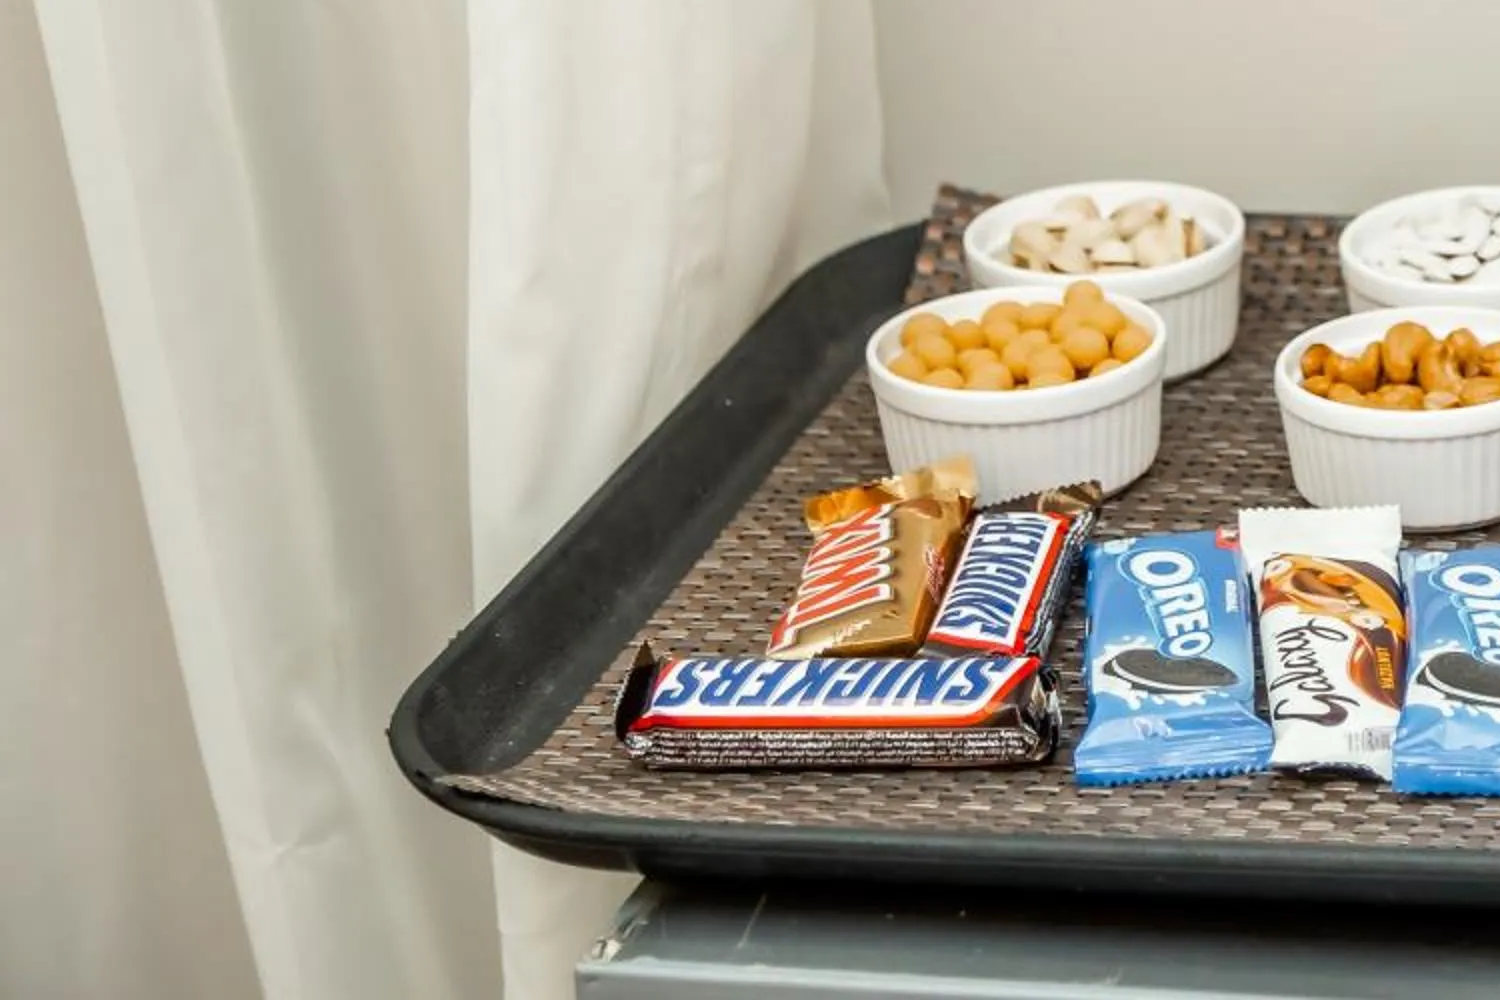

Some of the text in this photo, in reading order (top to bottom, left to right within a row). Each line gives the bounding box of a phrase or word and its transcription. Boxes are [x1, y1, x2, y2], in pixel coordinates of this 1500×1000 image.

[767, 504, 893, 657] TWIX
[942, 512, 1049, 637] SNICKER
[1128, 550, 1214, 657] OREO
[654, 659, 1007, 708] SNICKERS
[1270, 618, 1361, 727] Galaxy
